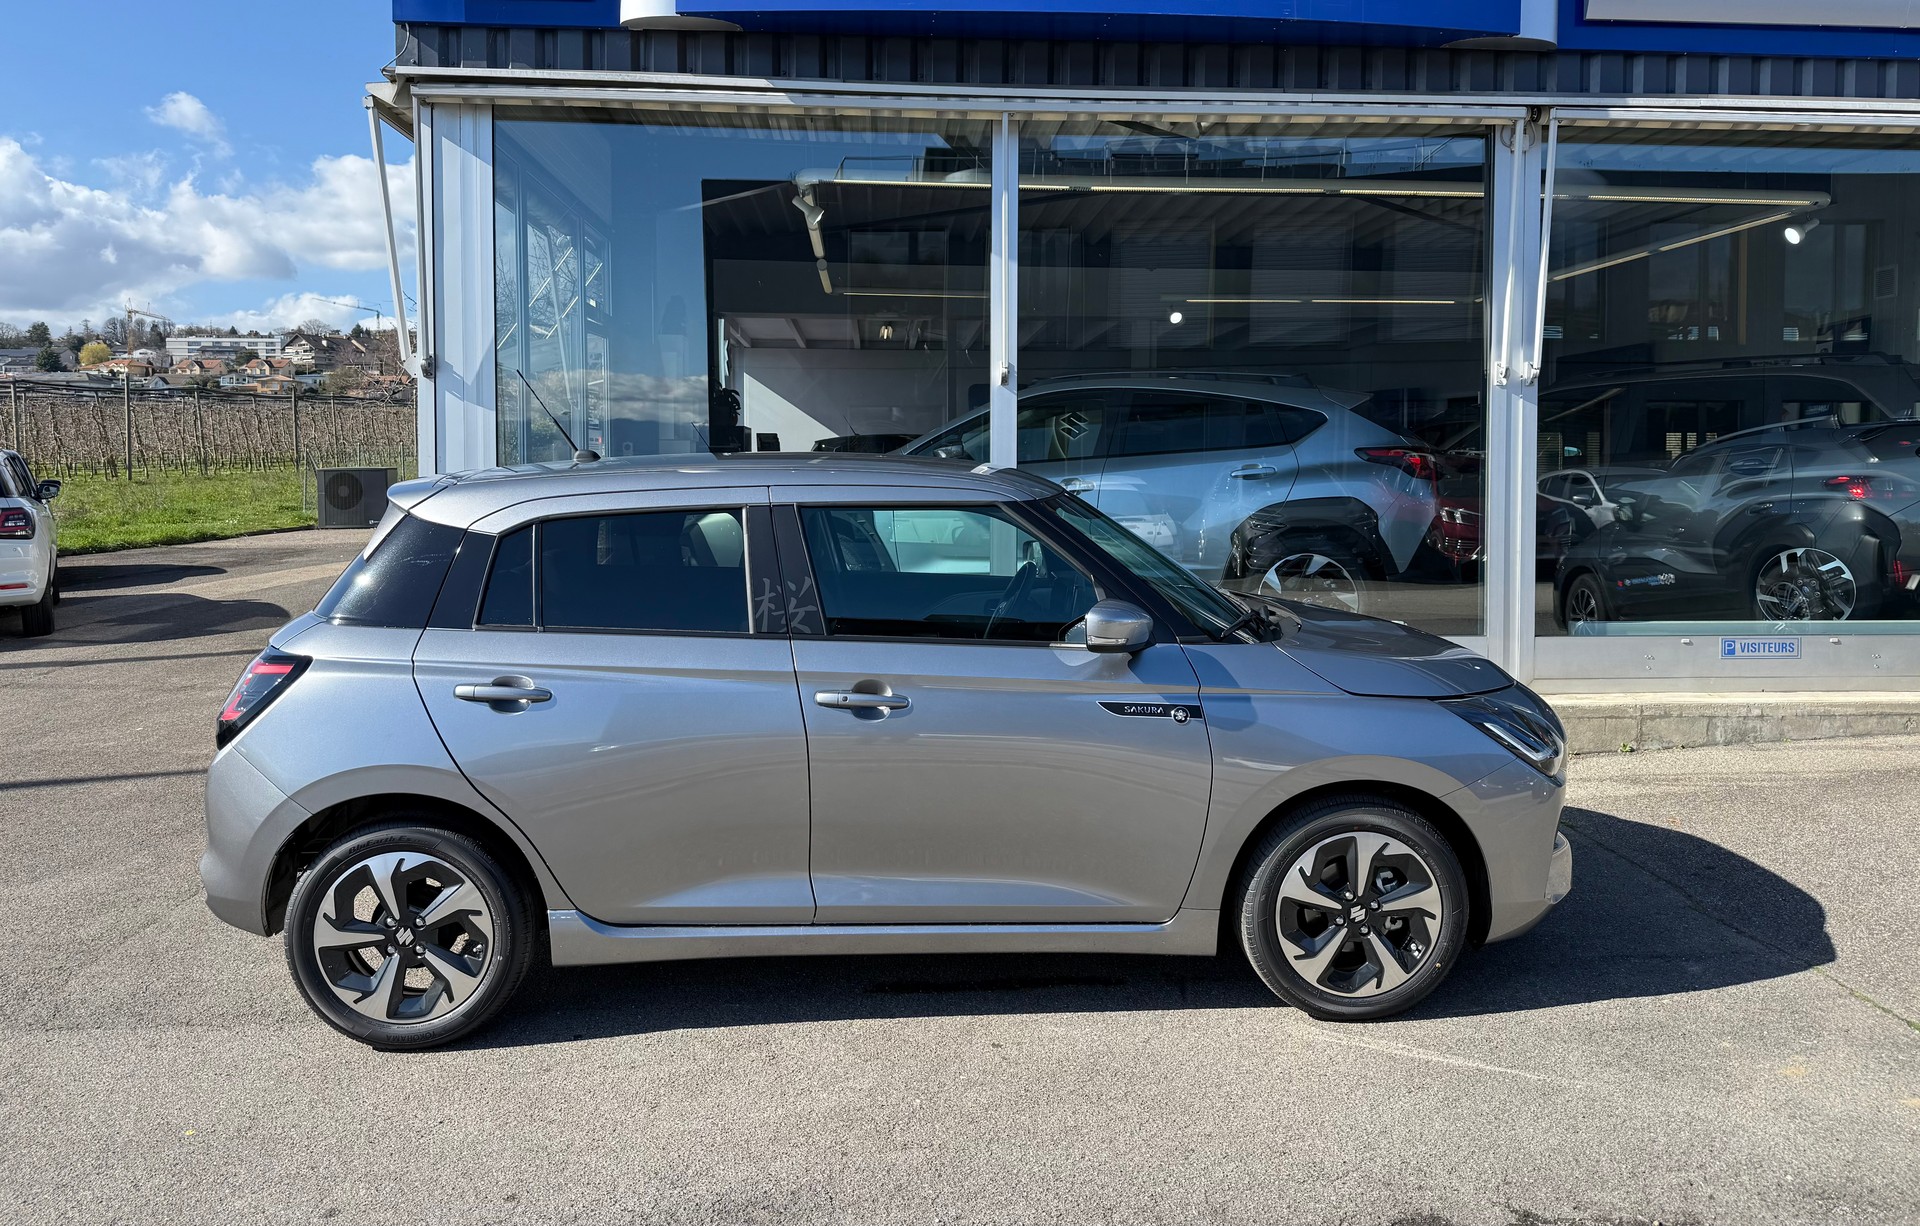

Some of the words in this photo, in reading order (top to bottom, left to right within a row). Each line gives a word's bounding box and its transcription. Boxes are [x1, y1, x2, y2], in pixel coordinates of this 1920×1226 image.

[755, 576, 818, 633] 桜
[1740, 642, 1795, 653] VISITEURS
[1124, 705, 1165, 714] SAKURA
[386, 1031, 437, 1041] YOKOHAMA
